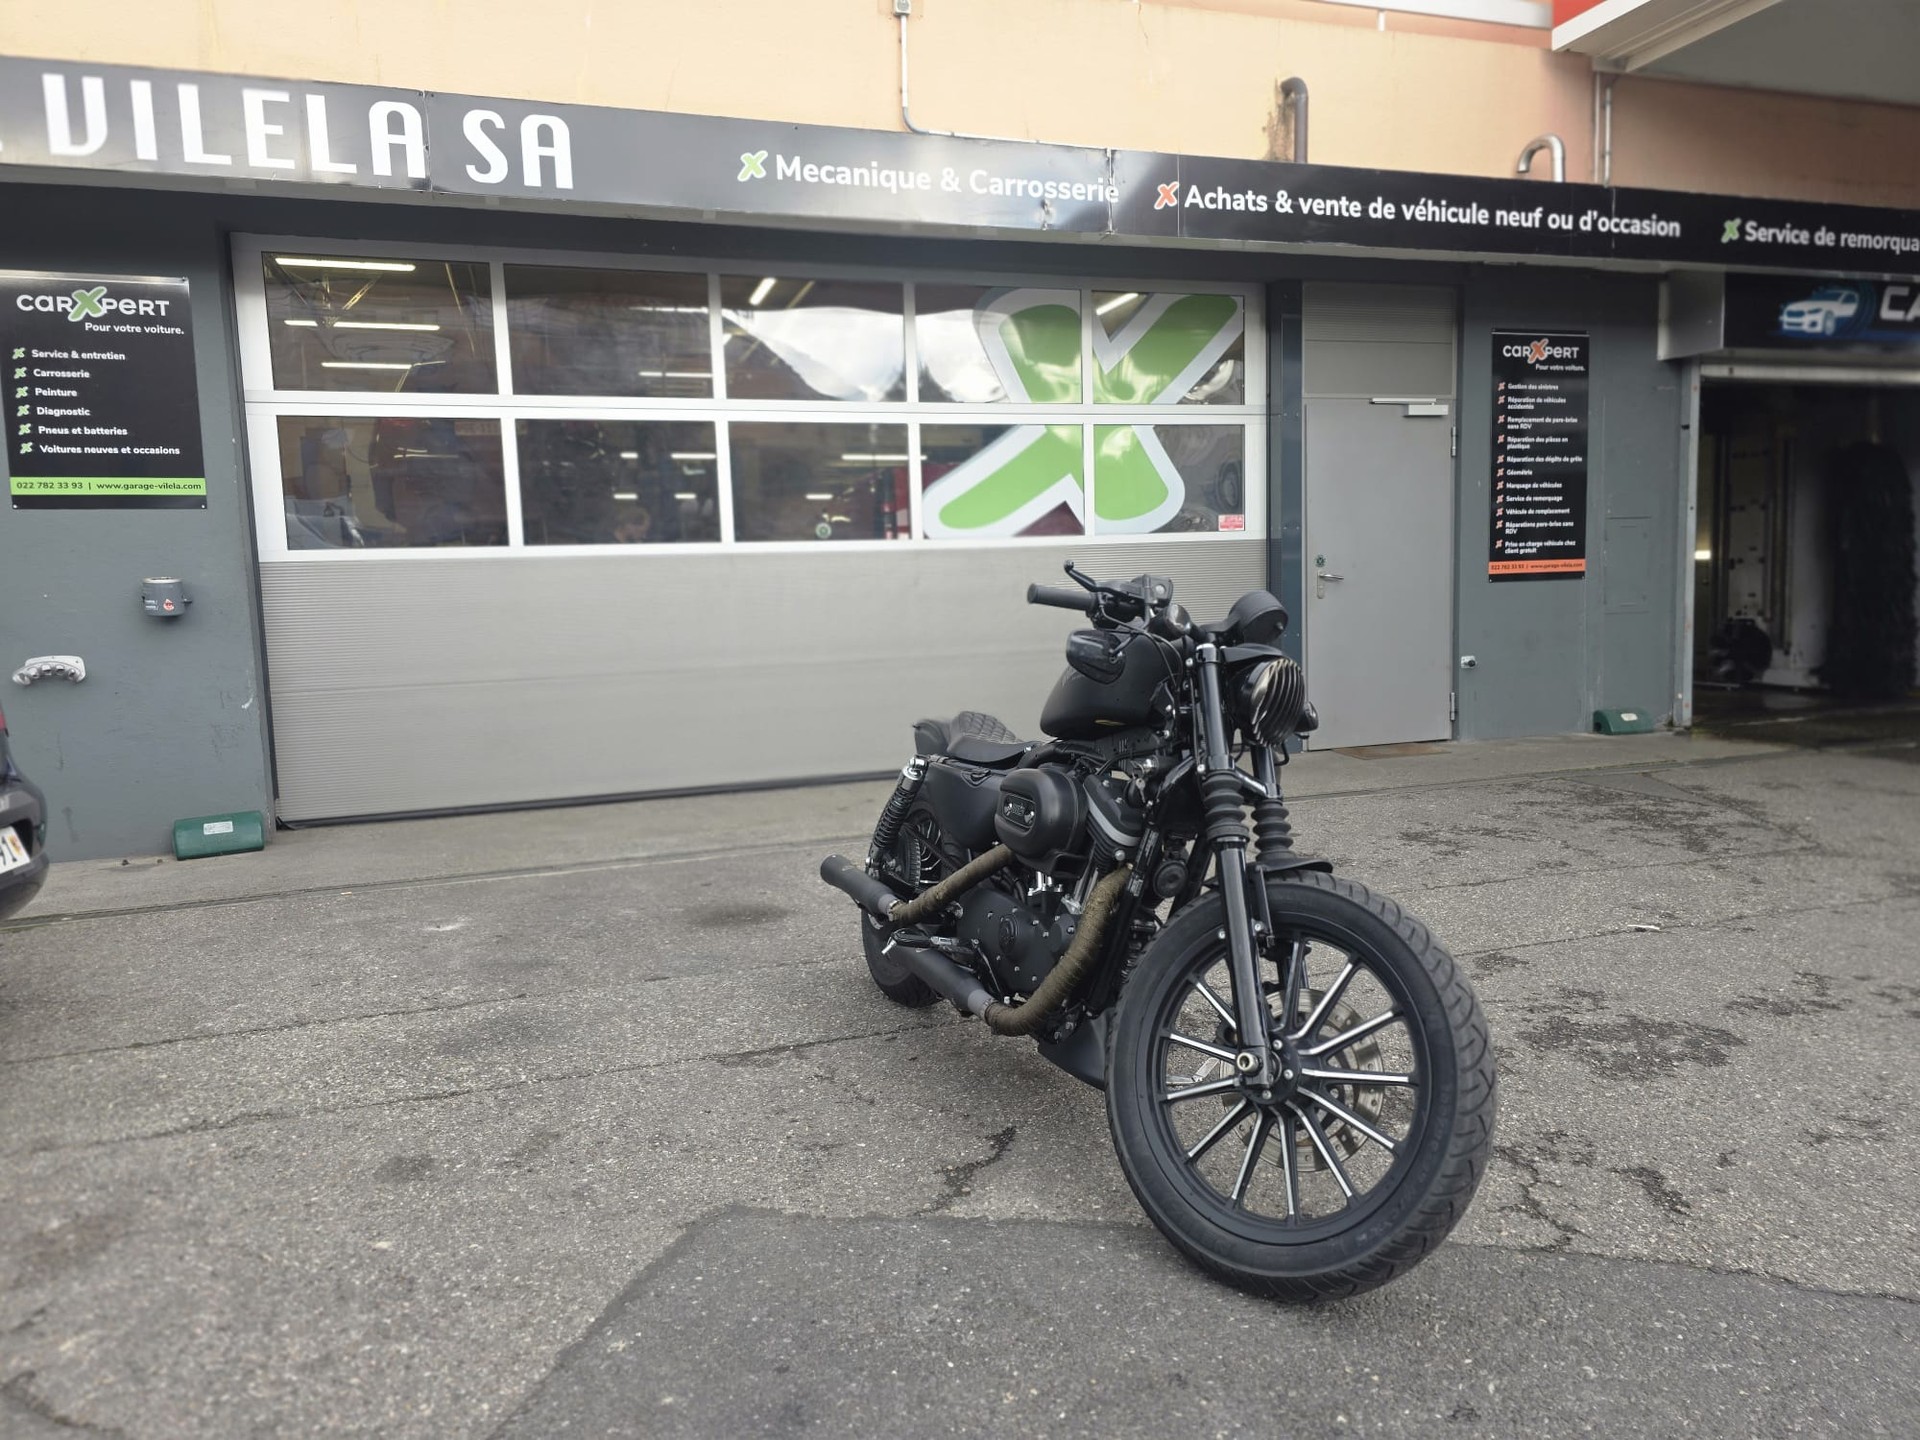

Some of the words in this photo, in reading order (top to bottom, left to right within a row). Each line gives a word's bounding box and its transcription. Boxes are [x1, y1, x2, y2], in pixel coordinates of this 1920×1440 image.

[42, 73, 428, 178] VILELA
[462, 109, 573, 189] SA
[776, 154, 931, 198] Mecanique
[940, 167, 961, 193] &
[970, 169, 1119, 203] Carrosserie
[1184, 184, 1268, 213] Achats
[1274, 190, 1293, 214] &
[1298, 194, 1361, 217] vente
[1368, 193, 1396, 220] de
[1401, 197, 1489, 226] véhicule
[1495, 207, 1542, 229] neuf
[1547, 213, 1573, 231] ou
[1745, 221, 1810, 245] Service
[1814, 226, 1835, 247] de
[1840, 232, 1920, 255] remorqua
[85, 322, 111, 332] Pour
[113, 323, 141, 333] votre
[144, 325, 184, 335] voiture.
[31, 349, 68, 359] Service
[71, 350, 80, 359] &
[81, 350, 126, 360] entretien
[33, 368, 90, 379] Carrosserie
[35, 387, 77, 397] Peinture
[36, 407, 91, 418] Diagnostic
[38, 426, 69, 435] Pneus
[71, 427, 83, 435] et
[84, 426, 128, 436] batteries
[39, 444, 82, 454] Voitures
[84, 446, 119, 454] neuves
[120, 446, 132, 454] et
[133, 446, 180, 455] occasions
[16, 481, 34, 490] 022
[37, 481, 55, 490] 782
[57, 481, 69, 490] 33
[71, 481, 83, 490] 93
[96, 481, 202, 491] www.garage-vilela.com
